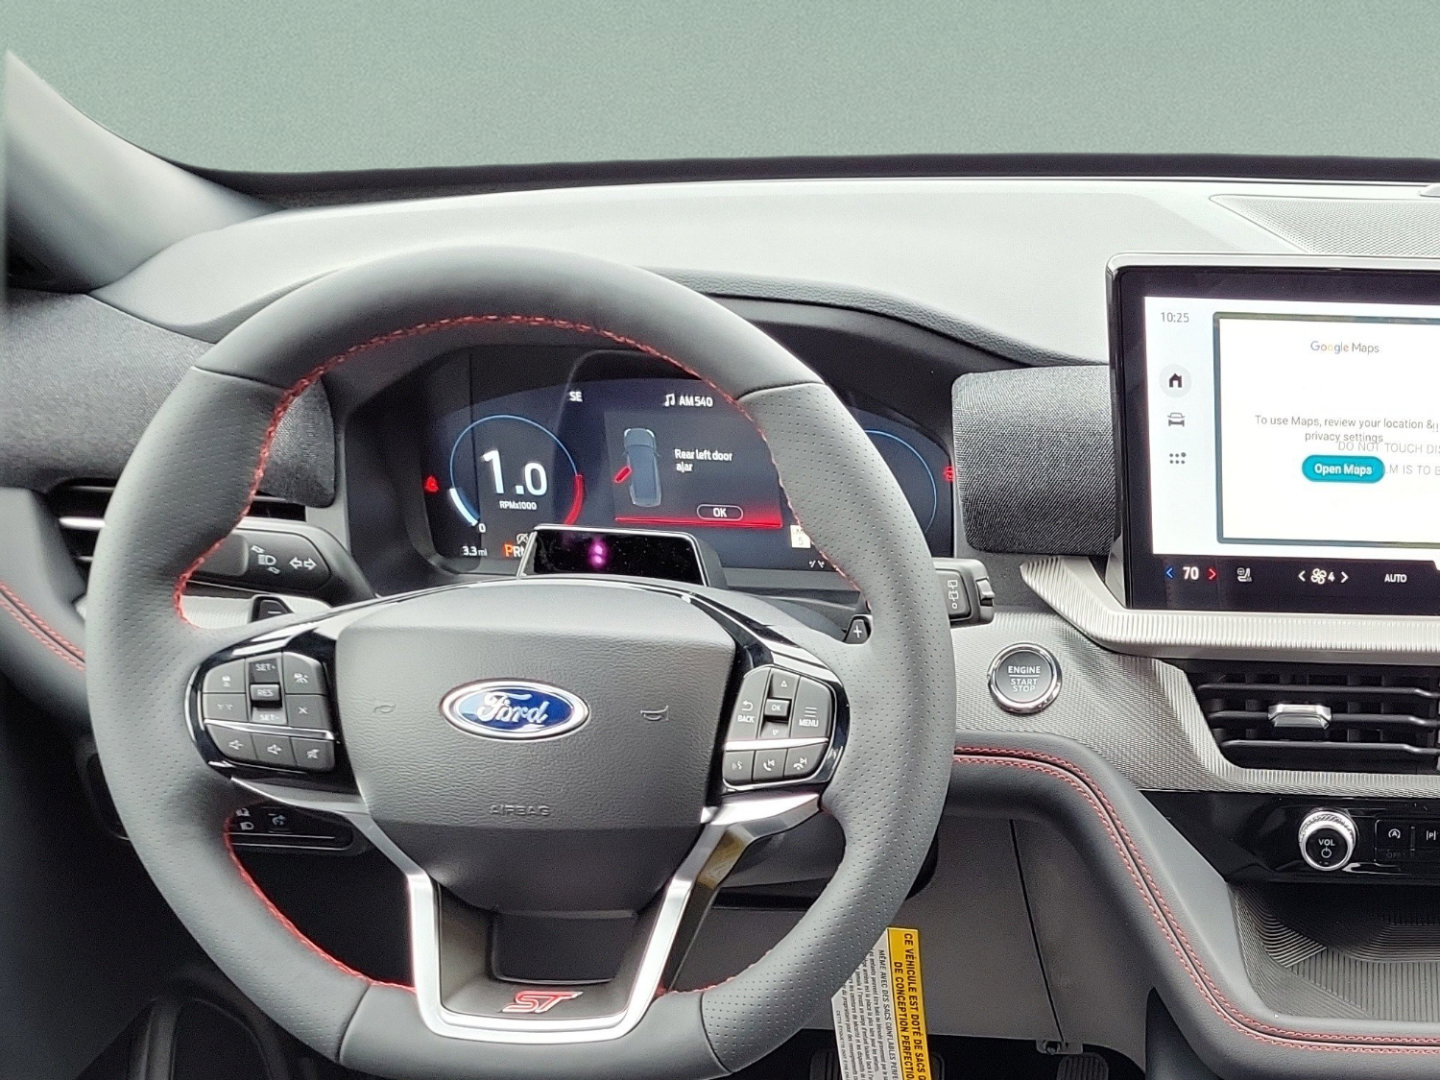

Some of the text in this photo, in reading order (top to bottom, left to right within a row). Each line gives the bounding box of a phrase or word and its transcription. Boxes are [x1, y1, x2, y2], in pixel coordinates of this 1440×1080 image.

[1161, 312, 1190, 323] 10:25
[1310, 341, 1380, 355] Google Maps
[569, 391, 583, 402] SE
[679, 395, 713, 407] AM 540
[1255, 415, 1267, 425] To
[1270, 417, 1288, 425] use
[1291, 416, 1322, 428] Maps,
[1324, 418, 1356, 428] review
[1359, 419, 1381, 429] your
[1384, 418, 1424, 429] location
[1305, 431, 1383, 444] privacy settings
[1338, 442, 1354, 452] DO
[1384, 442, 1423, 454] TOUCH
[674, 448, 733, 462] Rear left door
[481, 449, 548, 496] 1.0
[676, 461, 693, 473] ajar
[1314, 463, 1341, 476] Open
[1344, 463, 1372, 477] Maps
[1403, 464, 1413, 475] IS
[1417, 465, 1431, 475] TO
[713, 507, 727, 518] OK
[462, 545, 488, 557] 3.3 mi
[1183, 567, 1199, 580] 70
[1384, 573, 1407, 584] AUTO
[1007, 665, 1041, 674] ENGINE
[476, 691, 550, 724] Ford
[738, 714, 756, 723] BACK
[799, 718, 819, 728] MENU
[1318, 838, 1336, 848] VOL
[904, 933, 913, 945] CE
[893, 961, 902, 973] DE
[905, 948, 916, 992] VÉHICULE
[502, 990, 583, 1013] ST
[895, 976, 908, 1032] CONCEPTION
[908, 995, 918, 1011] EST
[910, 1014, 922, 1036] DOTÉ
[913, 1039, 922, 1050] DE
[914, 1052, 925, 1072] SACS
